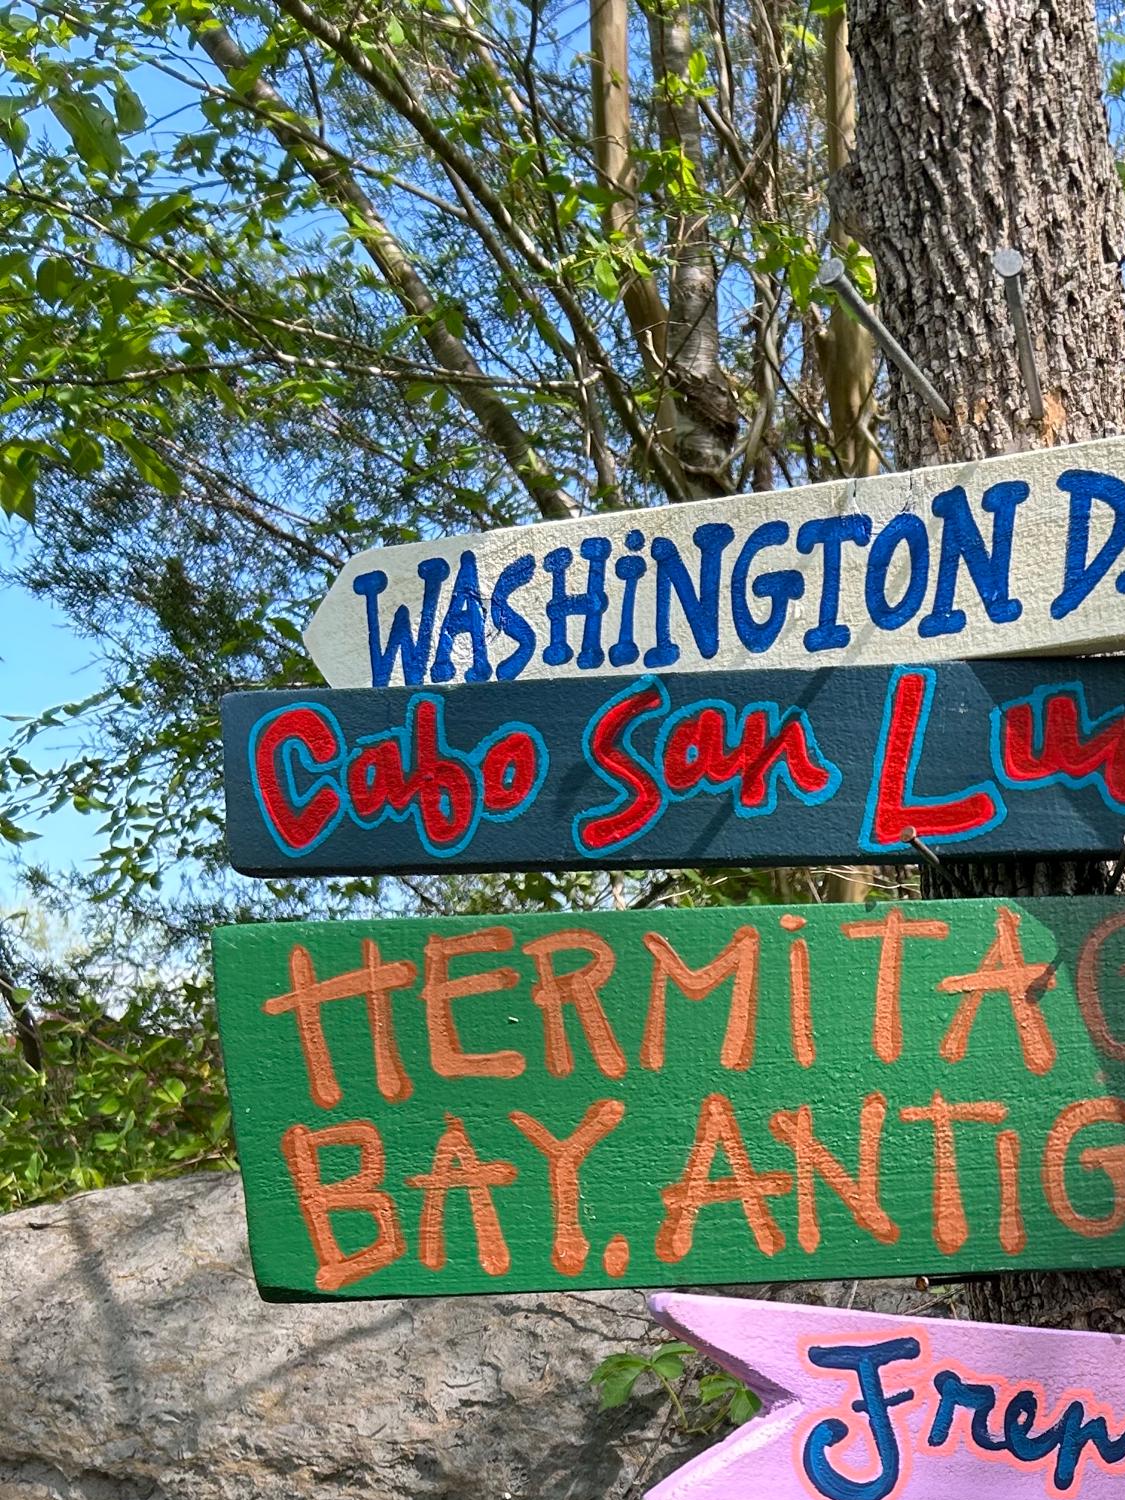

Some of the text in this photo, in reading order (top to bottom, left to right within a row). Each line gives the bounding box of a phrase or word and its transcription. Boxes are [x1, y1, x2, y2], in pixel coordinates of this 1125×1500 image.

[250, 692, 548, 858] Cabo
[573, 674, 842, 858] San
[282, 1098, 631, 1292] BAY.
